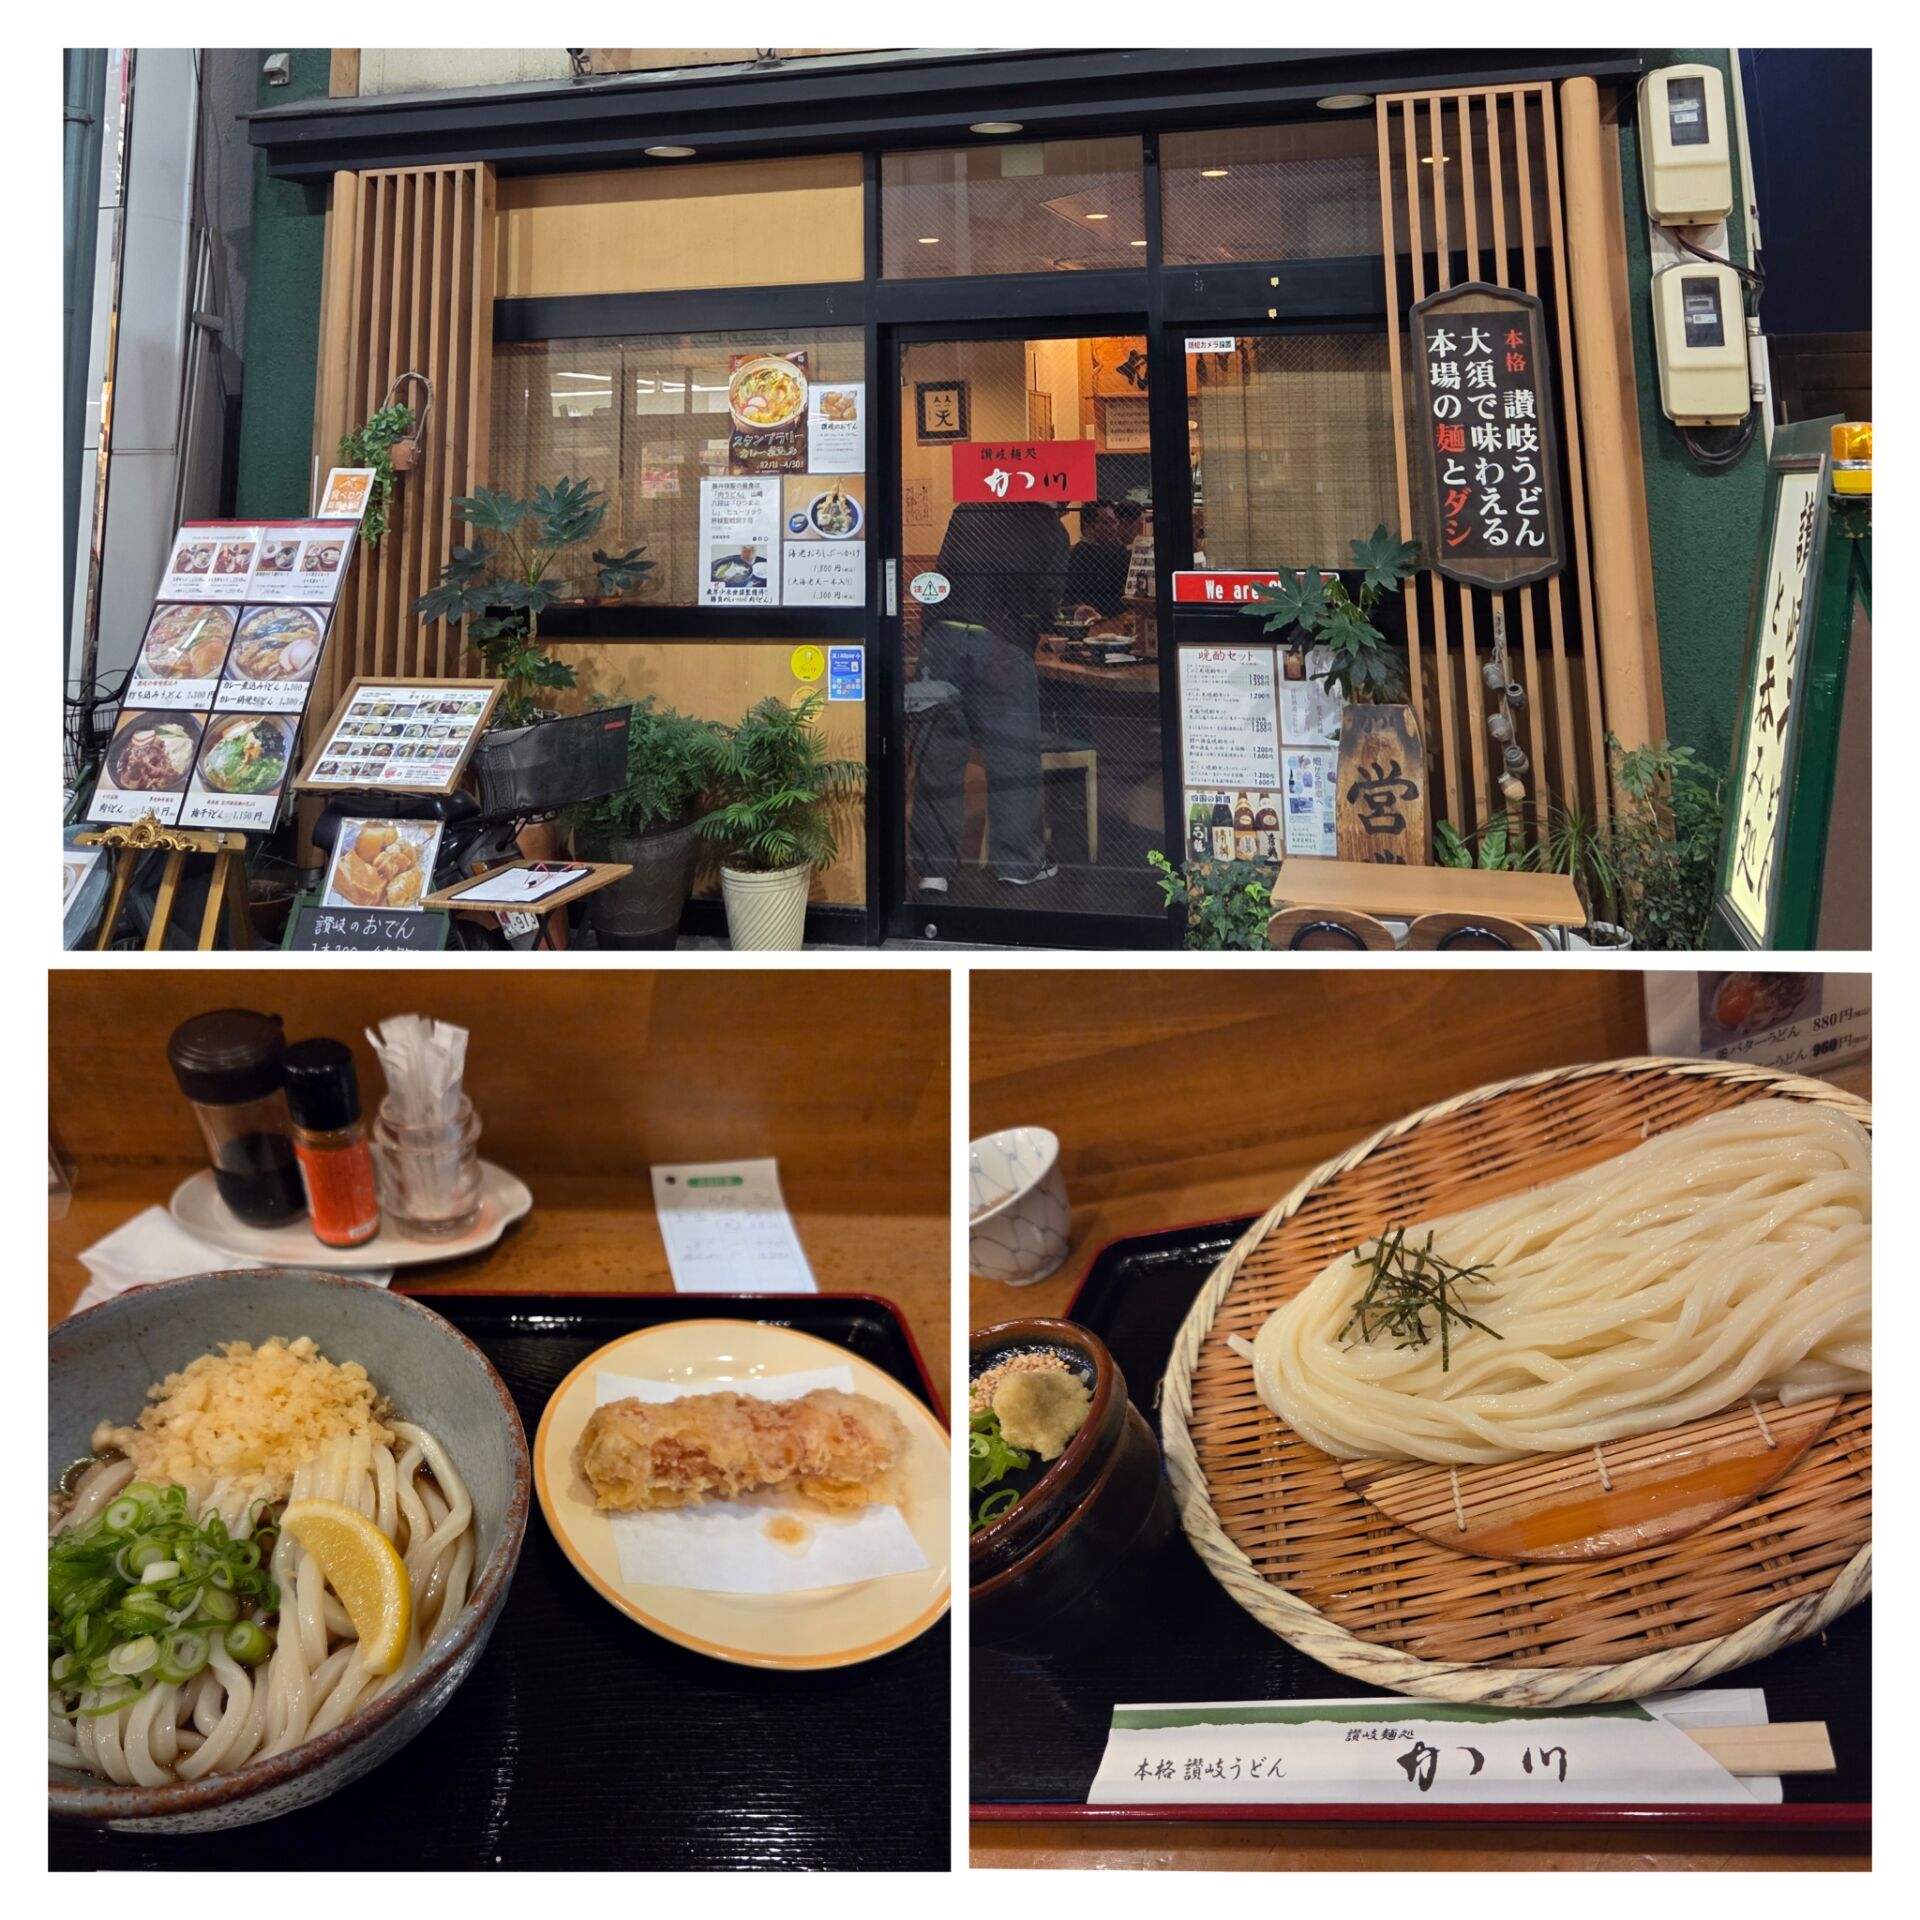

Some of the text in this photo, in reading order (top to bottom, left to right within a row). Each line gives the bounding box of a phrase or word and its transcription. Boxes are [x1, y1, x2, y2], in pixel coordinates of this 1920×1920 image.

[732, 430, 804, 447] スタンプラリー
[1427, 328, 1472, 547] 本場の麺とダシ
[1461, 327, 1509, 547] 大須で味わえる
[1503, 329, 1545, 548] 本格 讃岐うどん
[981, 447, 1037, 461] 讃岐麺処
[983, 468, 1068, 497] かつ川
[1205, 579, 1225, 600] We
[1198, 649, 1254, 661] 晩酌セット
[315, 914, 415, 940] 讃岐のおでん
[1345, 1728, 1415, 1742] 讃岐麺処
[1134, 1757, 1287, 1781] 本格 讃岐うどん
[1396, 1741, 1568, 1792] かつ川
